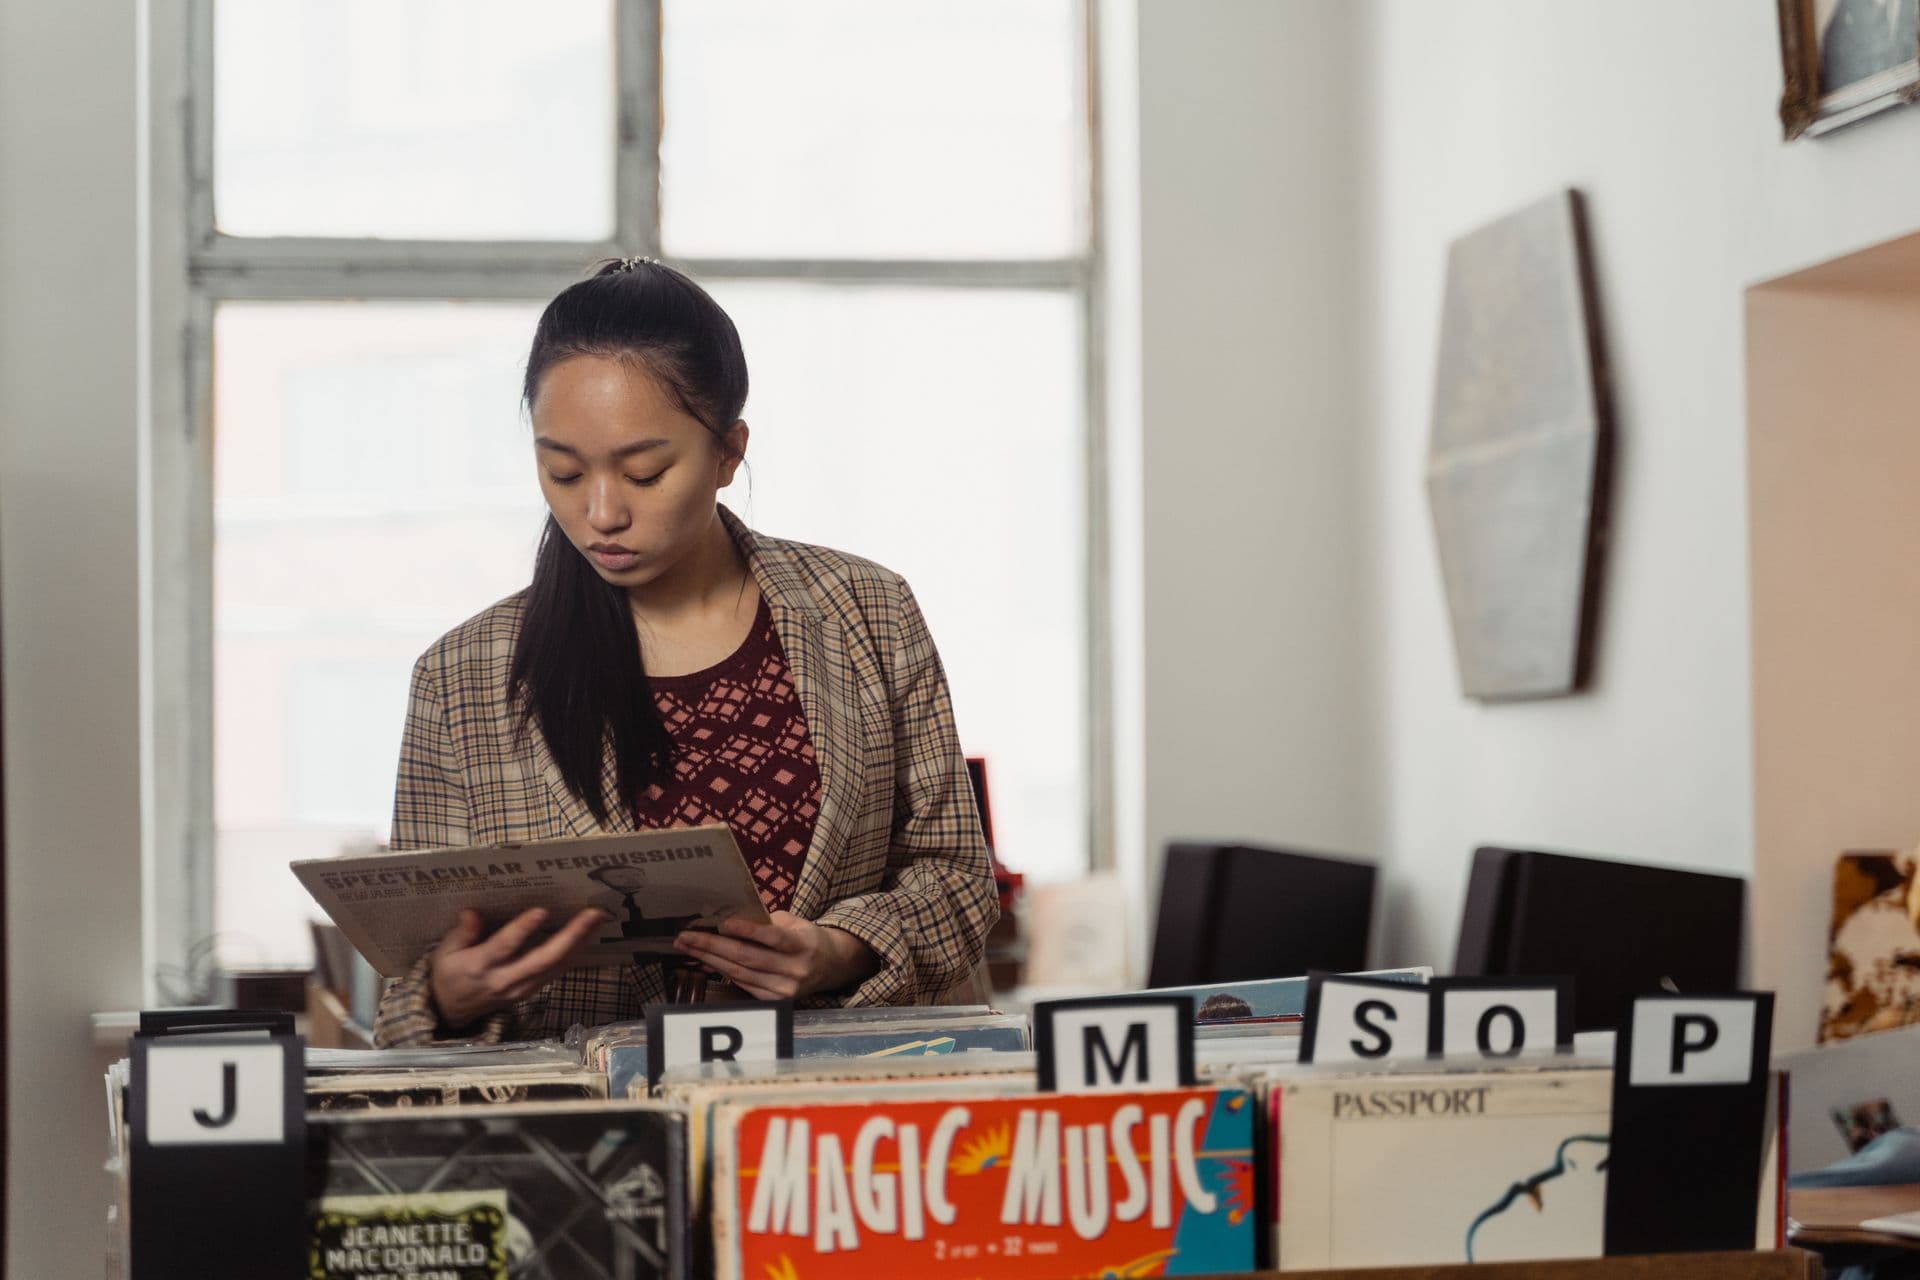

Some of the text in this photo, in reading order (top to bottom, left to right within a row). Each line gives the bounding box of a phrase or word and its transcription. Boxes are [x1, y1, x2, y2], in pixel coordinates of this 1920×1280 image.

[323, 861, 523, 890] SPECTACULAR
[536, 845, 714, 872] PERCUSSION
[699, 1025, 744, 1077] R
[1082, 1022, 1150, 1087] M
[1350, 999, 1398, 1059] S
[1476, 1004, 1526, 1059] O
[1670, 1013, 1720, 1074] P
[192, 1062, 239, 1129] J
[1333, 1087, 1491, 1117] PASSPORT
[748, 1098, 1217, 1253] MAGIC MUSIC
[325, 1243, 487, 1272] MACDONALD
[341, 1223, 472, 1249] JEANETTE
